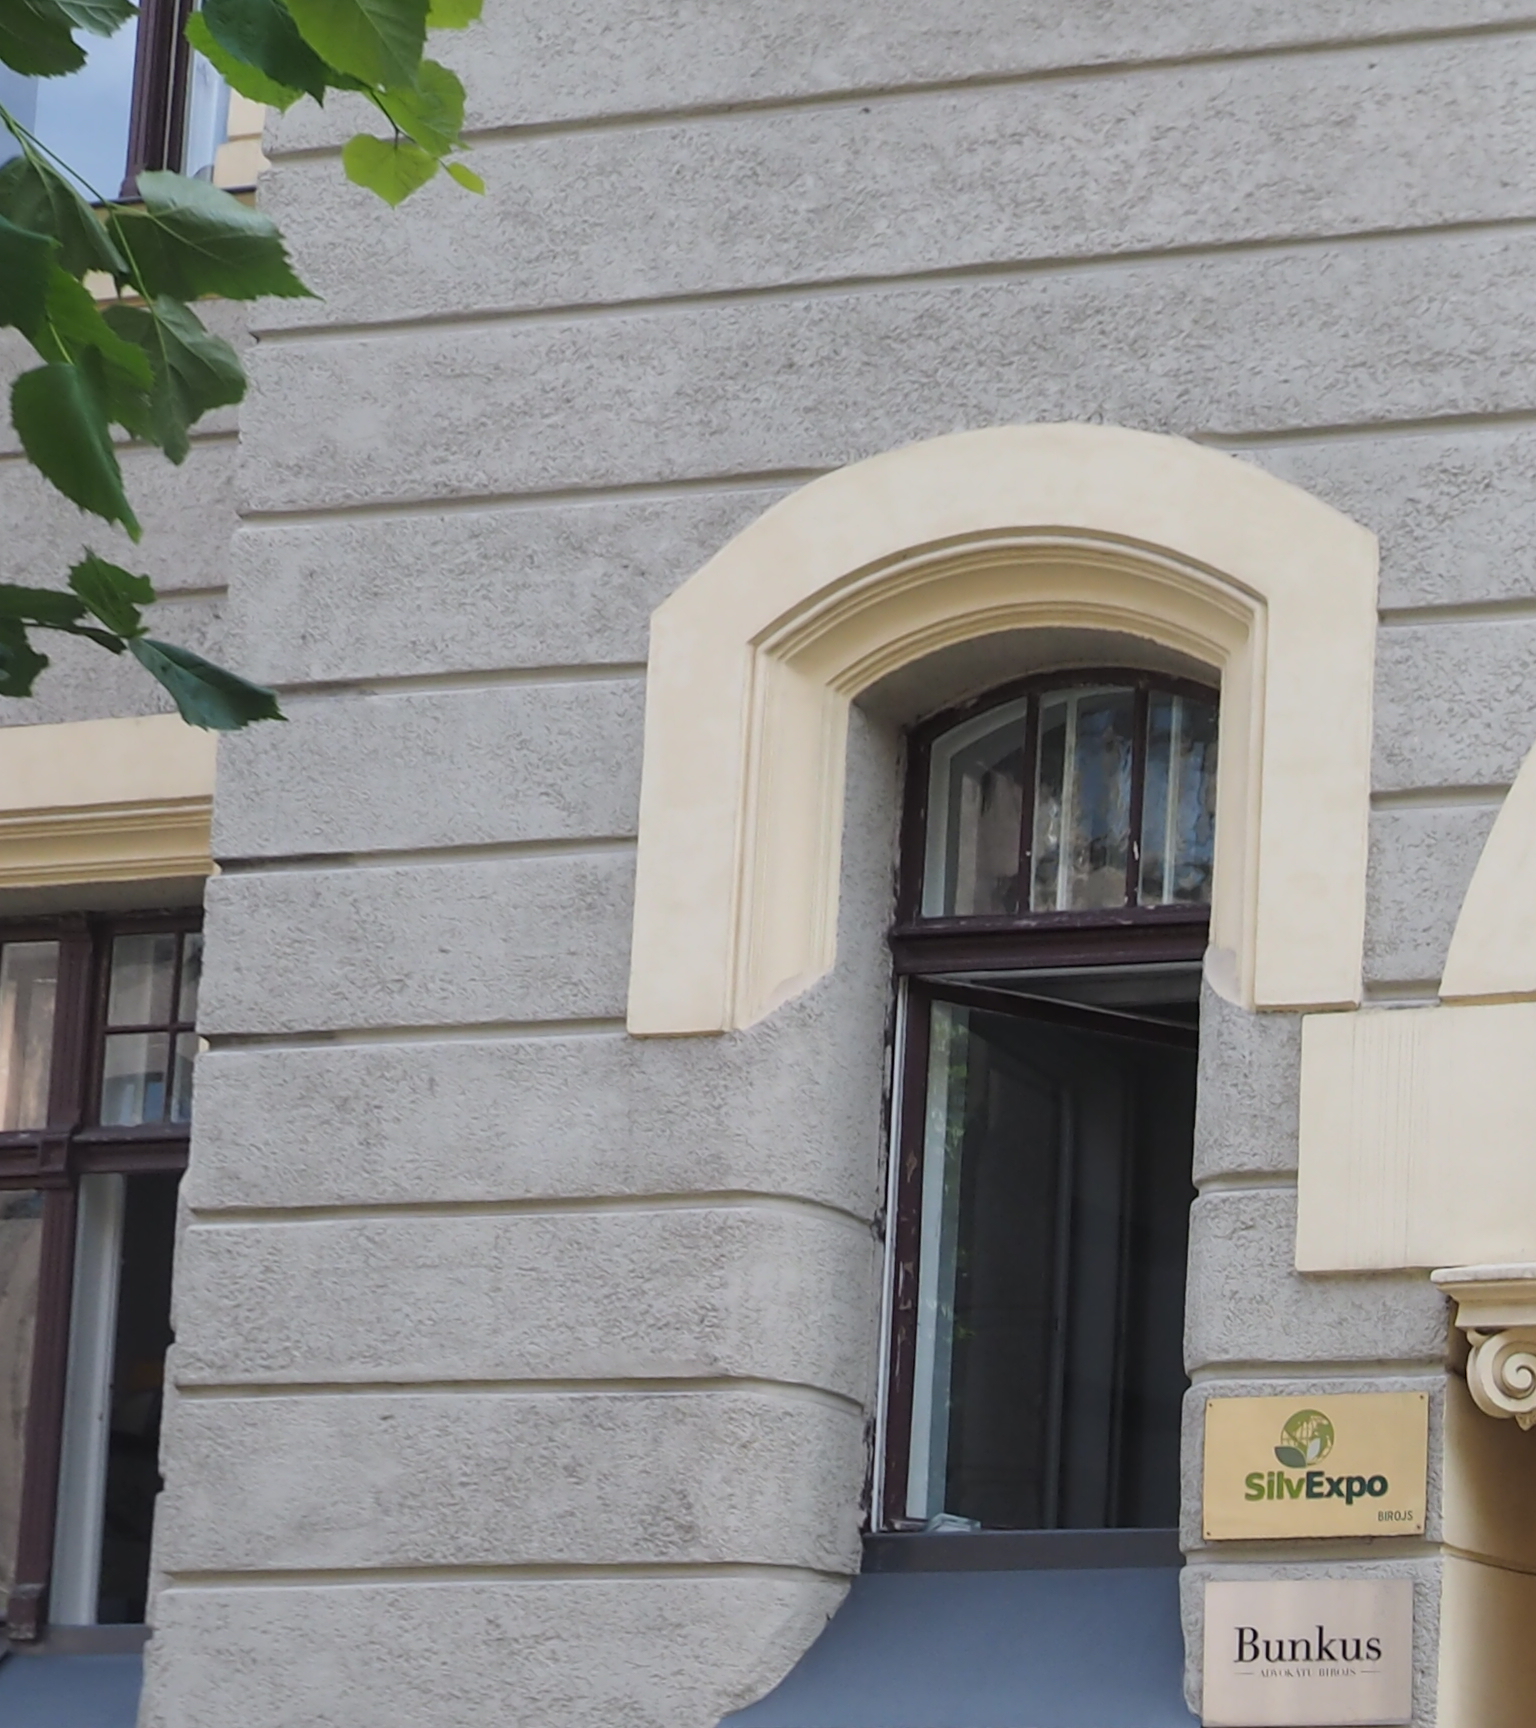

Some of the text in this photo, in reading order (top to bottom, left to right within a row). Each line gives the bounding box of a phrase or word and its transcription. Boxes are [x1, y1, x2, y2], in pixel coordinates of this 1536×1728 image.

[1244, 1471, 1388, 1505] SilvExpo
[1378, 1511, 1413, 1522] BIROJS
[1233, 1625, 1382, 1663] Bunkus
